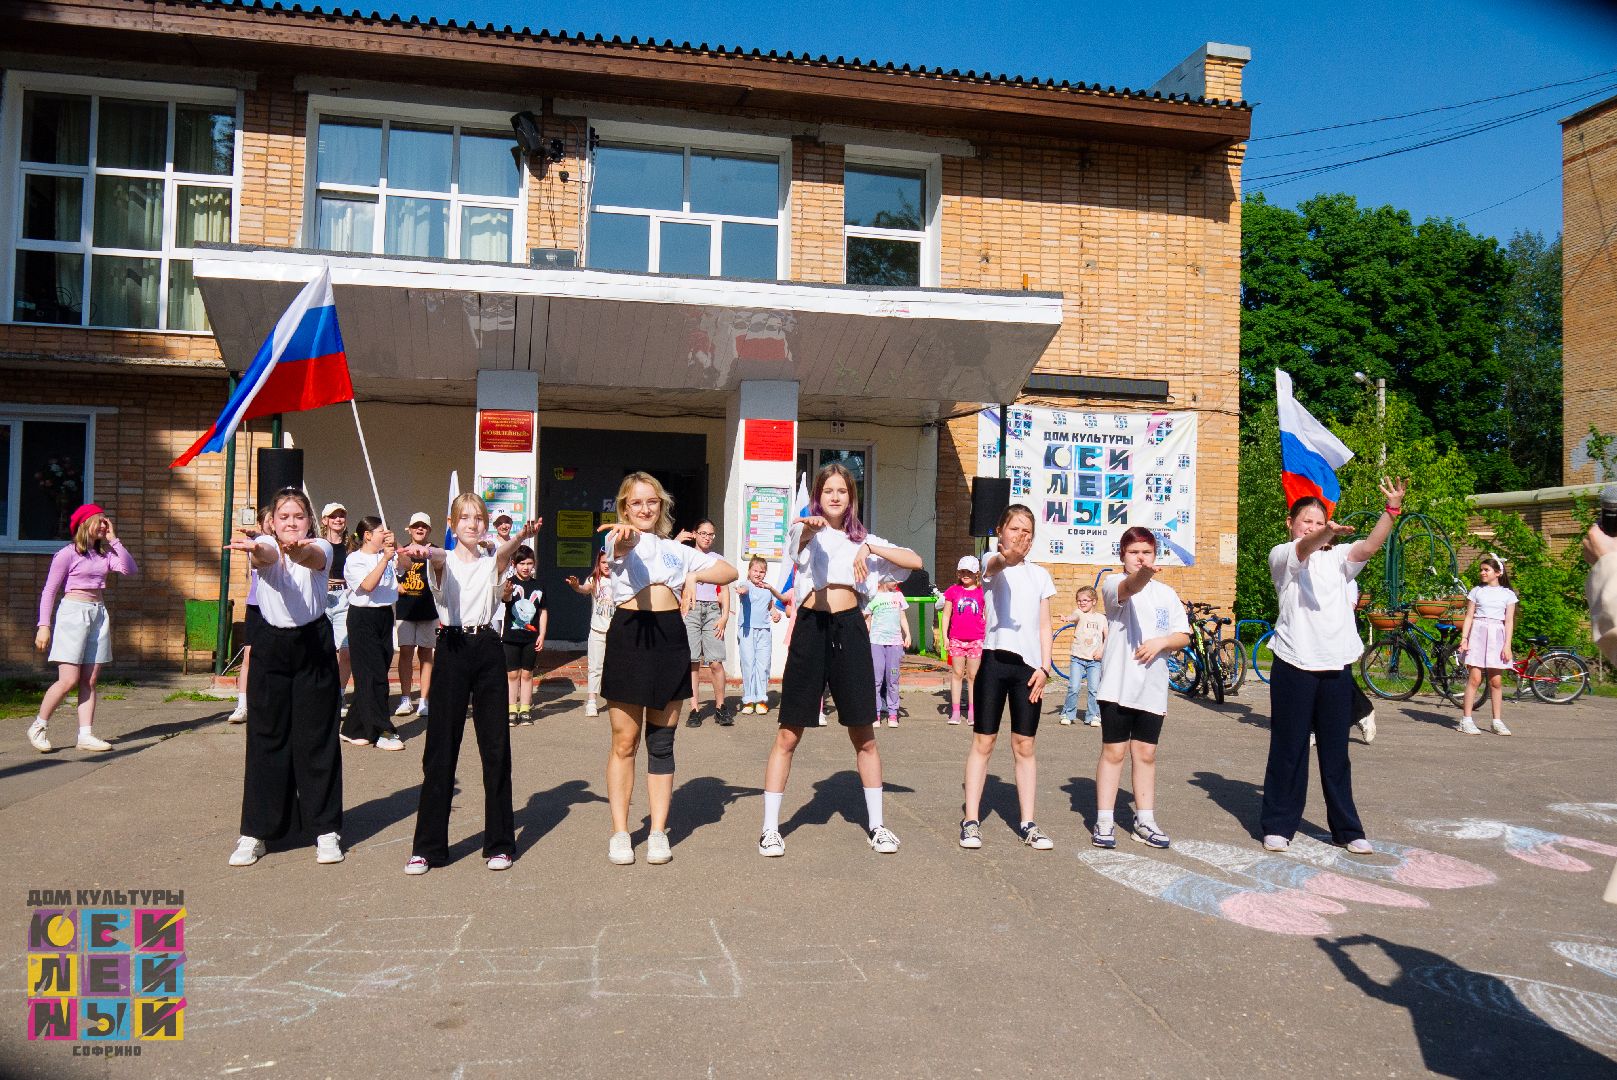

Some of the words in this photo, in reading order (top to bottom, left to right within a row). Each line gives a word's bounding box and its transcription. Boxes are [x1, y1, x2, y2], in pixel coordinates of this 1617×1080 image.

[1043, 431, 1069, 441] ДОМ
[1071, 432, 1134, 445] КУЛЬТУРЫ
[1067, 528, 1108, 536] СОФРИНО
